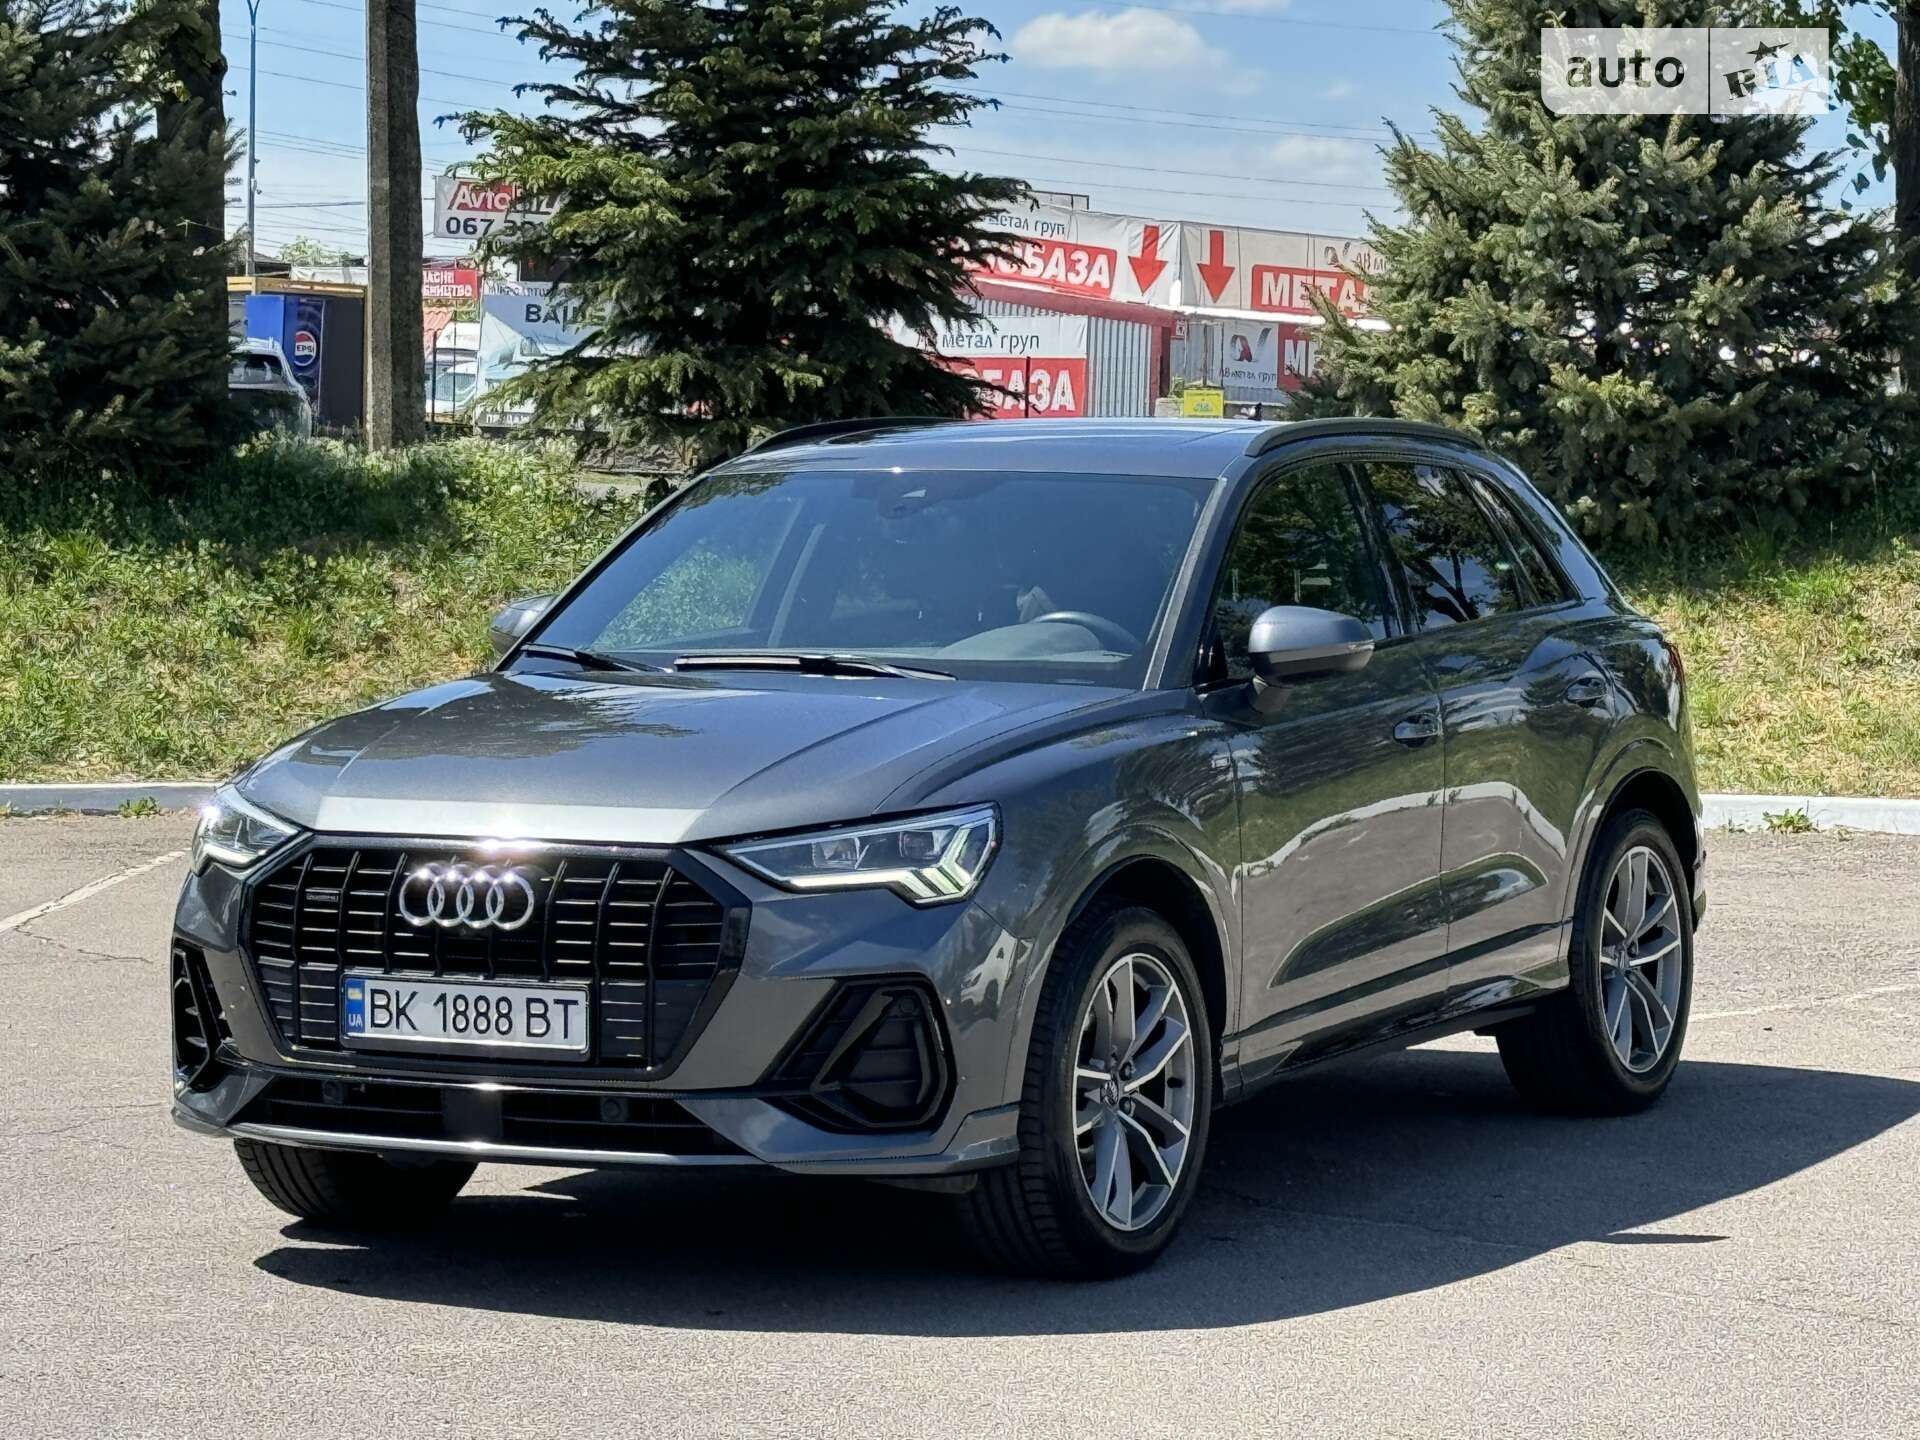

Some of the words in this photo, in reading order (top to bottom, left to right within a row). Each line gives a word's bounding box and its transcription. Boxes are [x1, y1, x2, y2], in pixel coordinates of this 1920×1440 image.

[445, 216, 495, 236] 067
[1034, 219, 1066, 237] груп
[942, 332, 993, 349] метал
[1000, 333, 1040, 355] груп
[348, 1013, 363, 1028] UA
[370, 988, 418, 1031] BK
[432, 991, 513, 1035] 1888
[525, 996, 579, 1040] BT
